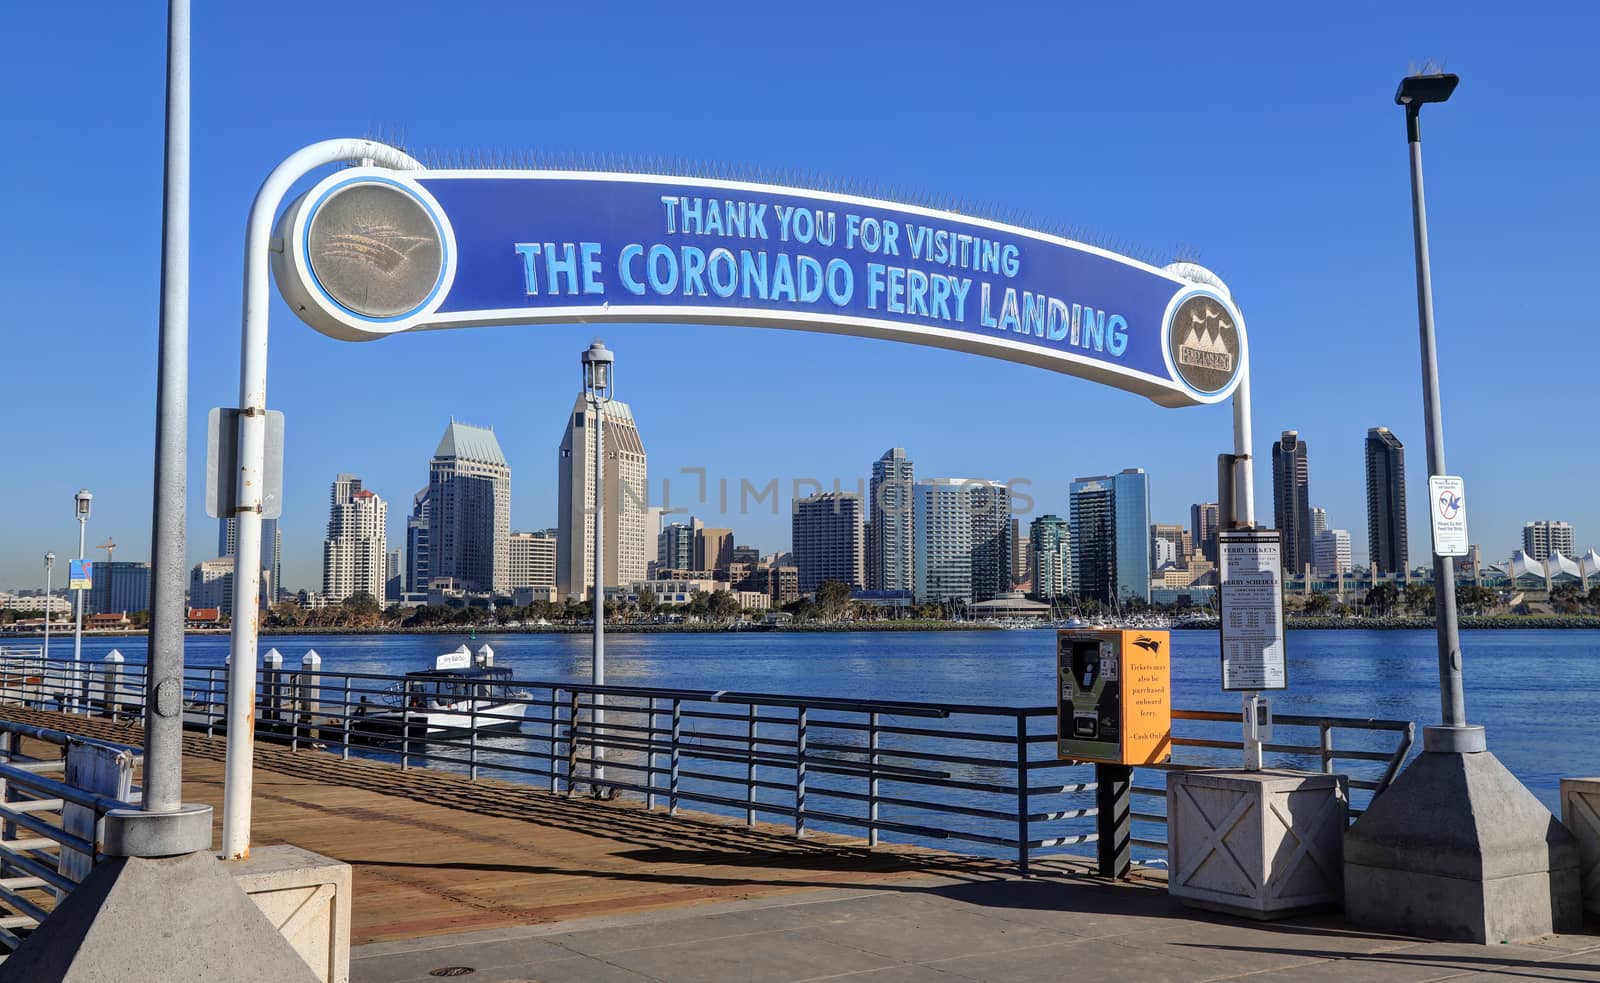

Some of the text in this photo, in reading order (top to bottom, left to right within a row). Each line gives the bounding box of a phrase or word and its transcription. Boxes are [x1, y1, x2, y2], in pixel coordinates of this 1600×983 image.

[661, 195, 1020, 278] THANK YOU FOR VISITING
[515, 242, 1129, 357] THE CORONADO FERRY LANDING
